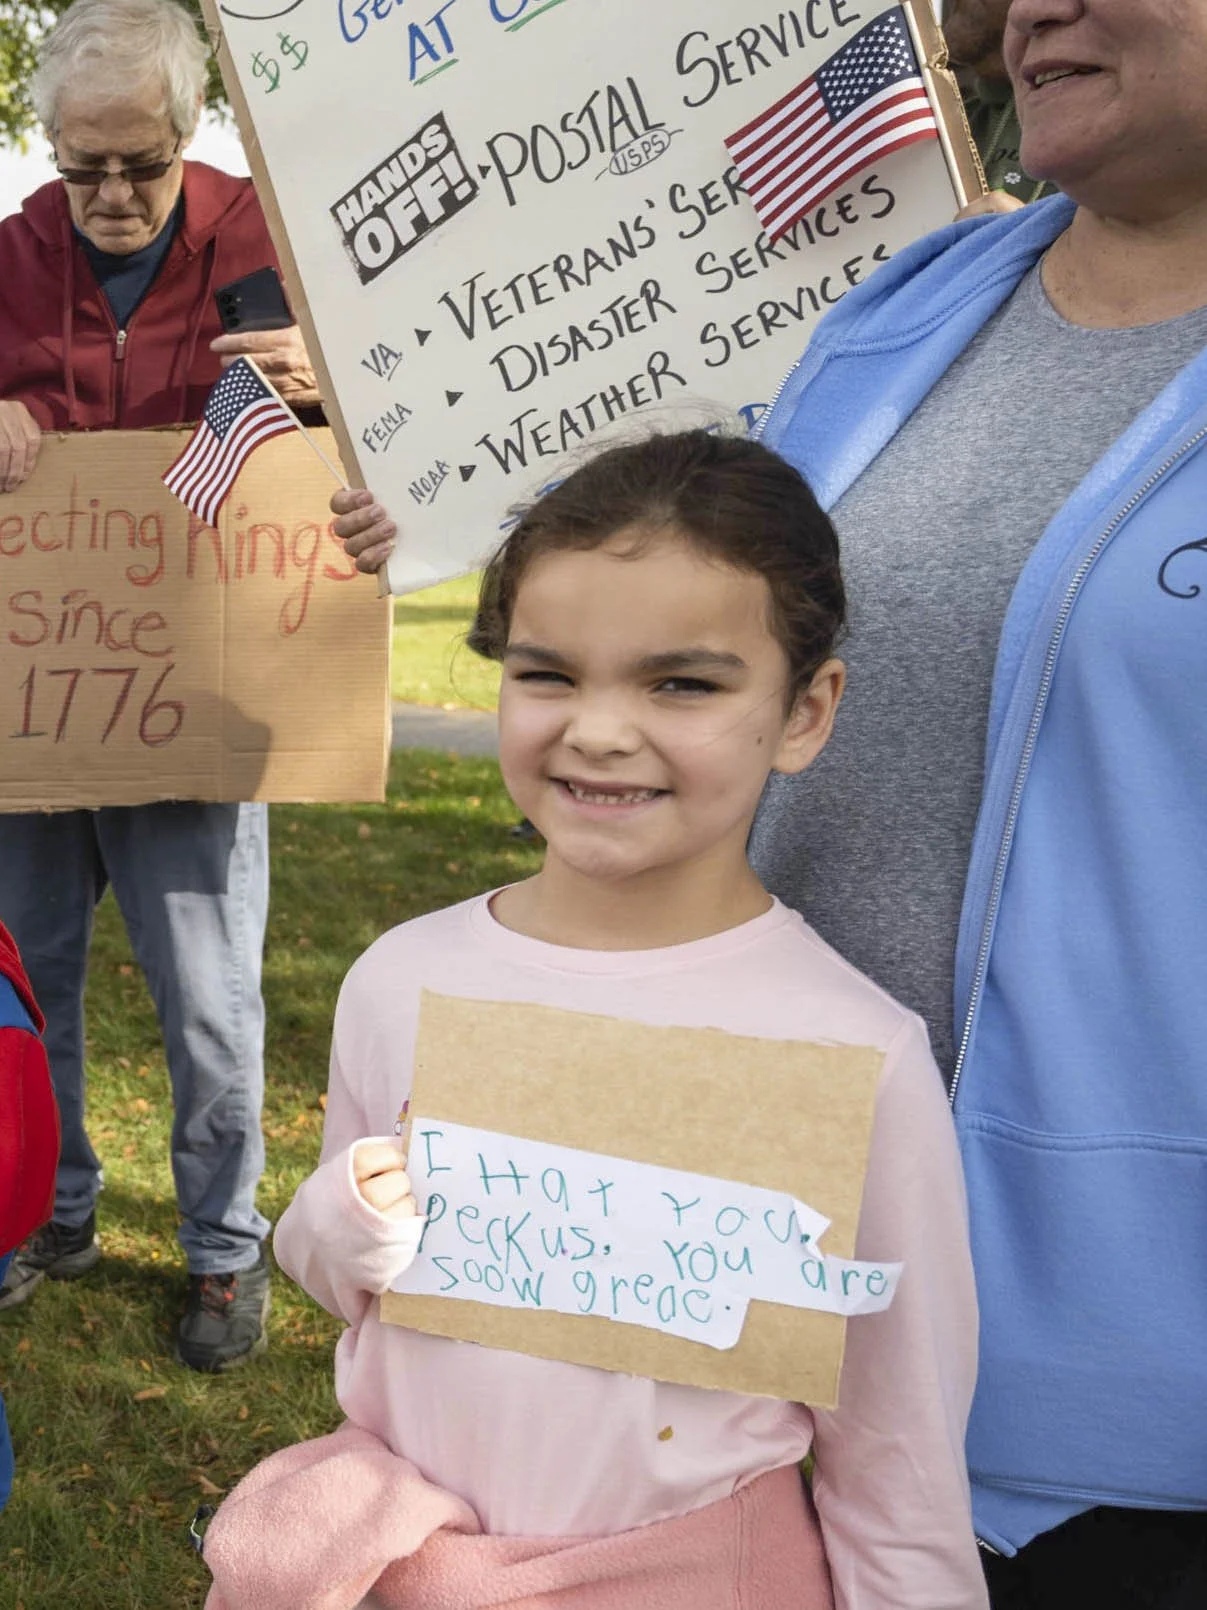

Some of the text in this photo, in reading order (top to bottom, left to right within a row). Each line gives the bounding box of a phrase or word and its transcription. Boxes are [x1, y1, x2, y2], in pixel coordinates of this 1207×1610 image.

[407, 0, 456, 81] AT
[336, 123, 448, 233] HANDS
[486, 76, 666, 206] POSTAL
[613, 133, 665, 176] USPS
[353, 150, 473, 269] OFF!
[489, 278, 677, 392] DISASTER
[361, 402, 413, 454] FEMA
[474, 350, 687, 475] WEATHER
[407, 458, 451, 505] NOAA
[8, 663, 185, 748] 1776
[420, 1130, 453, 1178] I
[800, 1258, 888, 1296] are
